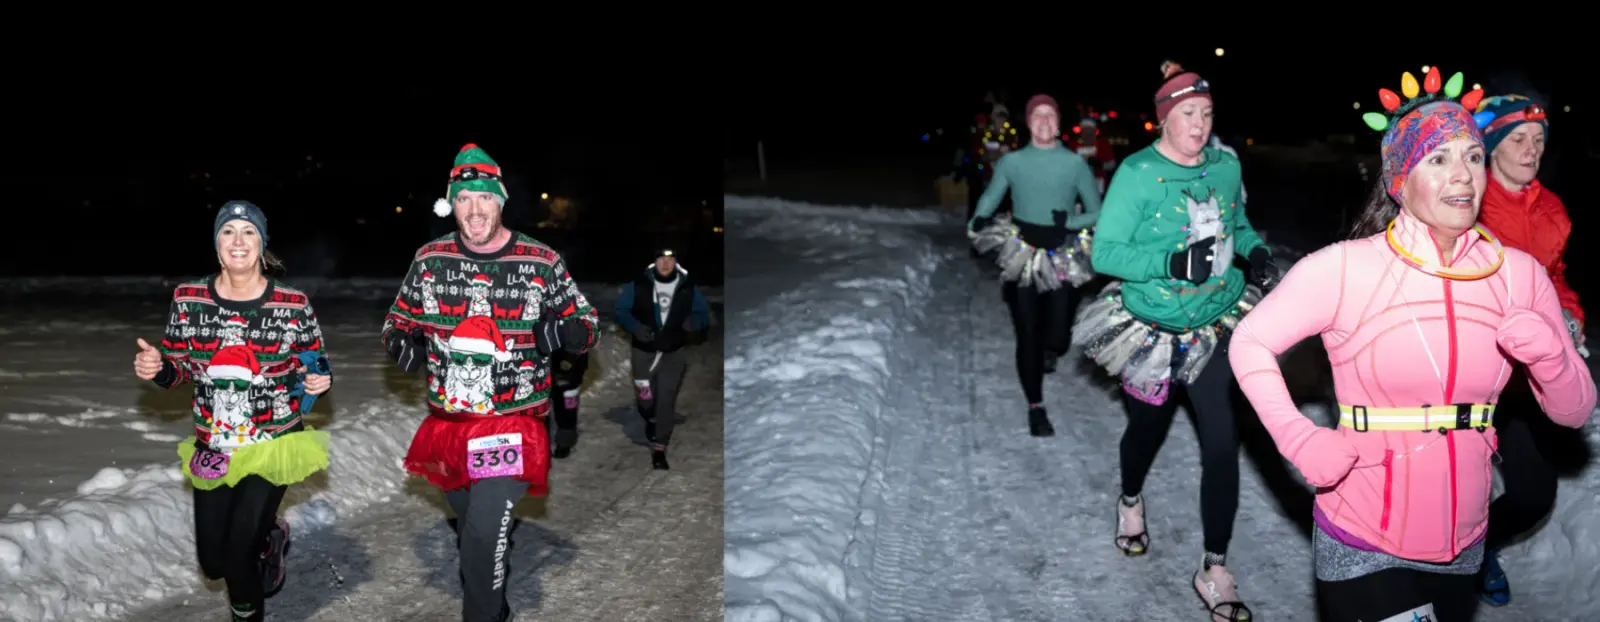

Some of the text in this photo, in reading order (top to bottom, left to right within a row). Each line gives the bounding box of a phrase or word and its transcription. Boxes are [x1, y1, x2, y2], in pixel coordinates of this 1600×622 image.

[460, 261, 500, 273] MA FA
[518, 264, 536, 275] MA
[273, 308, 292, 318] MA
[195, 451, 225, 471] 182
[472, 448, 518, 468] 330
